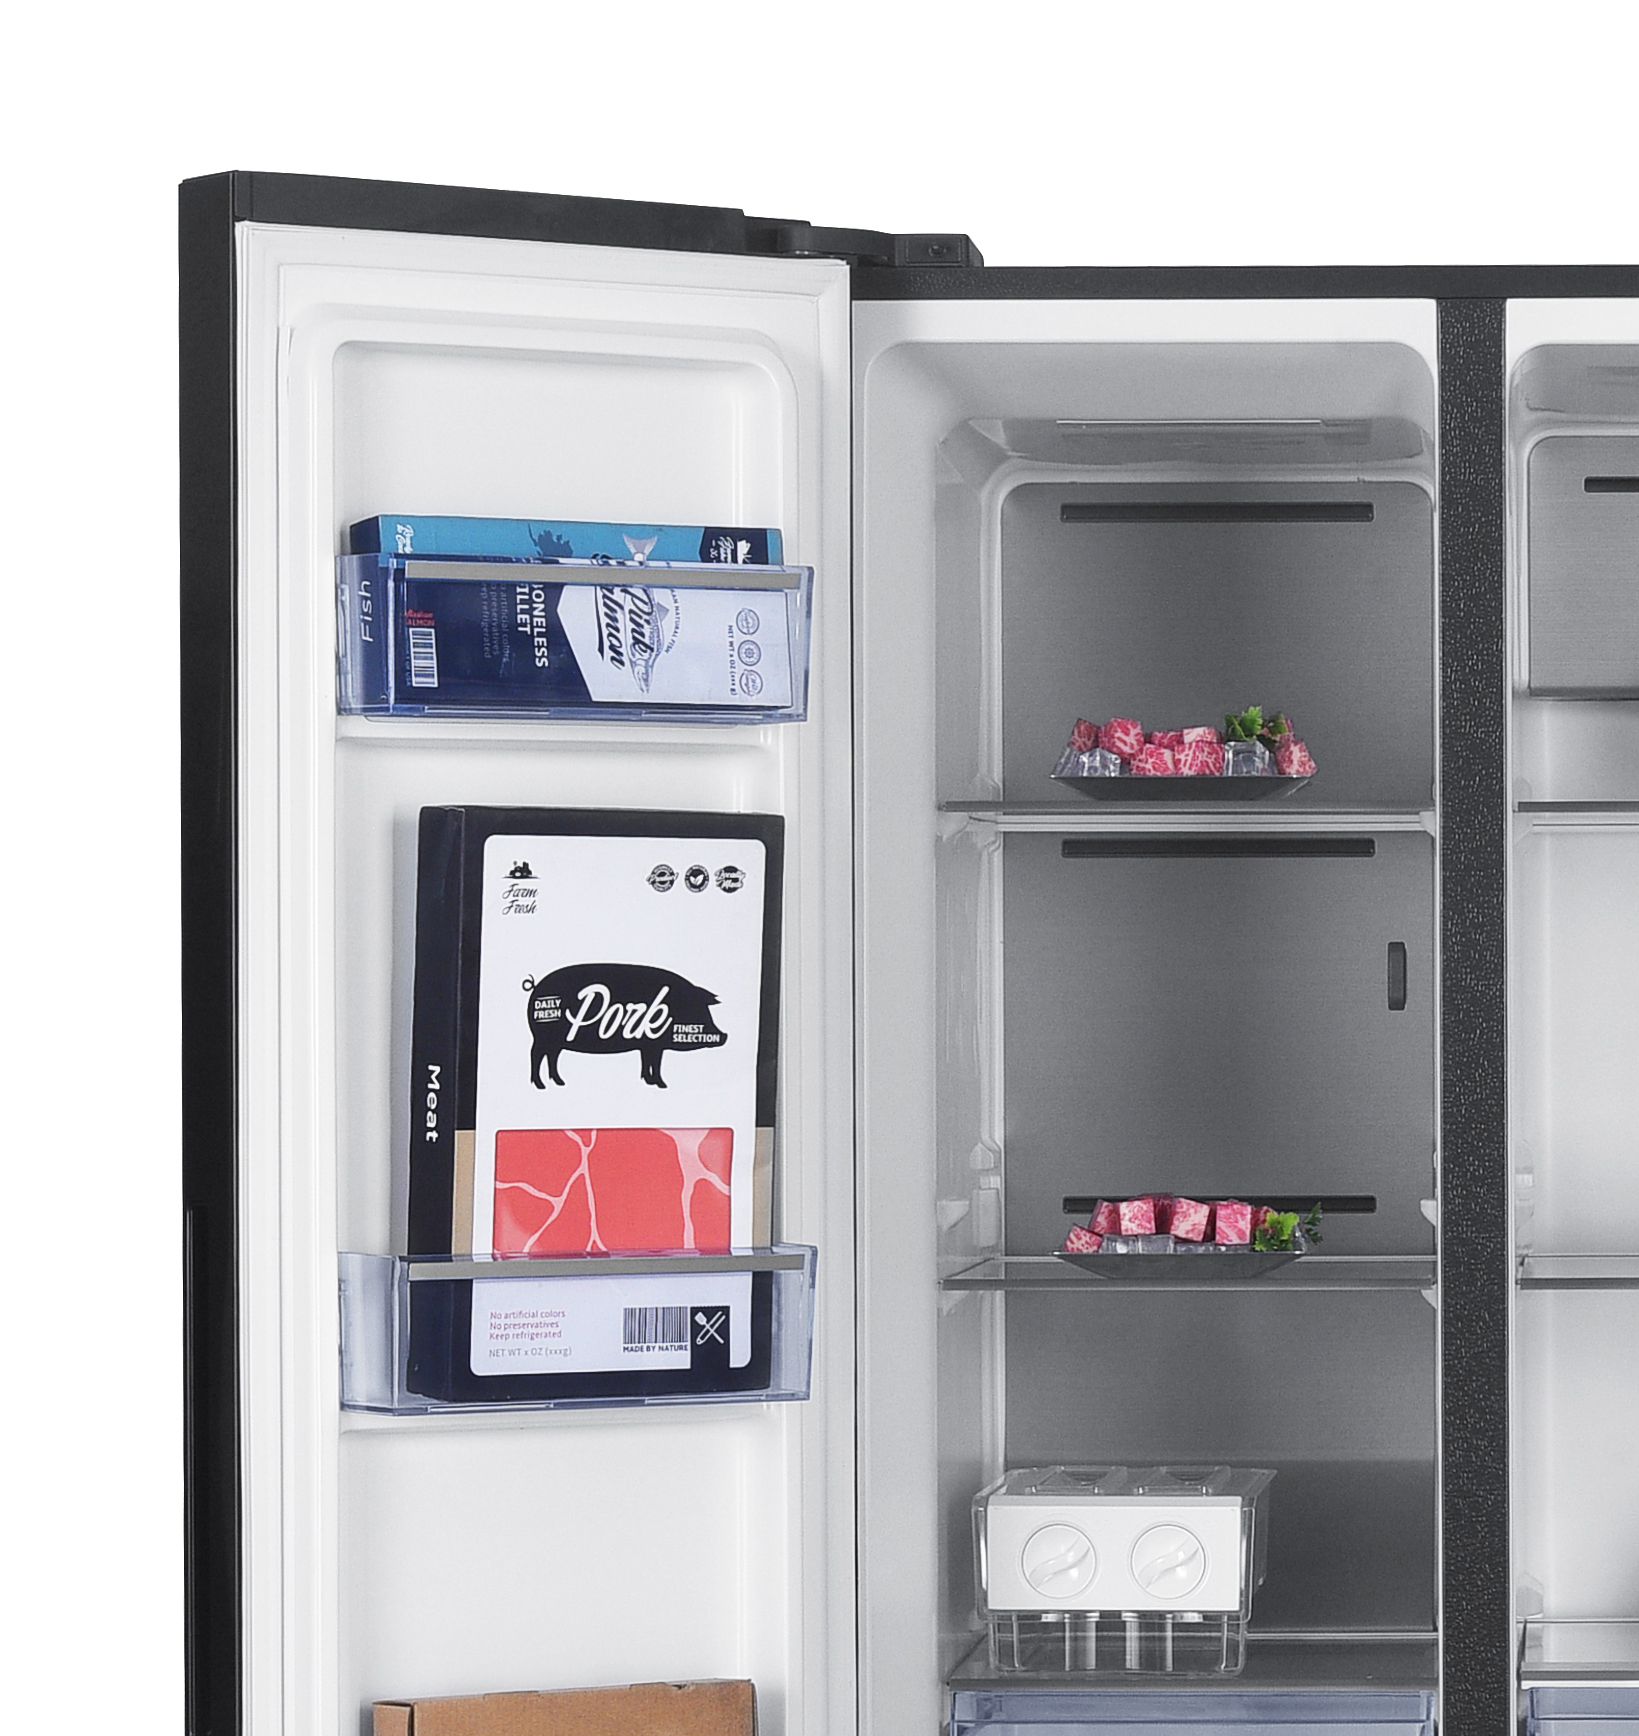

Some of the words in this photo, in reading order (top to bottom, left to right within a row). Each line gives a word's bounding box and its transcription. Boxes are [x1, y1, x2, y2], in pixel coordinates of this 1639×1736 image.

[358, 580, 373, 642] Fish
[515, 584, 531, 635] ILLET
[621, 586, 654, 657] Pink
[672, 605, 681, 638] NATURAL
[665, 639, 677, 654] FISH
[728, 640, 735, 651] WT
[502, 883, 539, 899] Farm
[502, 899, 538, 915] Fresh
[534, 999, 562, 1010] DAILY
[534, 1009, 562, 1020] FRESH
[565, 983, 673, 1042] Pork
[673, 1024, 704, 1034] FINEST
[672, 1033, 720, 1043] SELECTION
[426, 1065, 441, 1142] Meat
[490, 1311, 502, 1320] No
[504, 1310, 538, 1320] artificial
[540, 1310, 566, 1319] colors
[490, 1322, 502, 1331] No
[503, 1321, 559, 1332] preservatives
[489, 1332, 510, 1342] Keep
[512, 1330, 562, 1341] refrigerated
[489, 1349, 506, 1358] NET
[508, 1348, 523, 1357] WT
[531, 1347, 544, 1357] OZ
[623, 1345, 644, 1353] MADE
[646, 1345, 657, 1353] BY
[658, 1344, 689, 1353] NATURE
